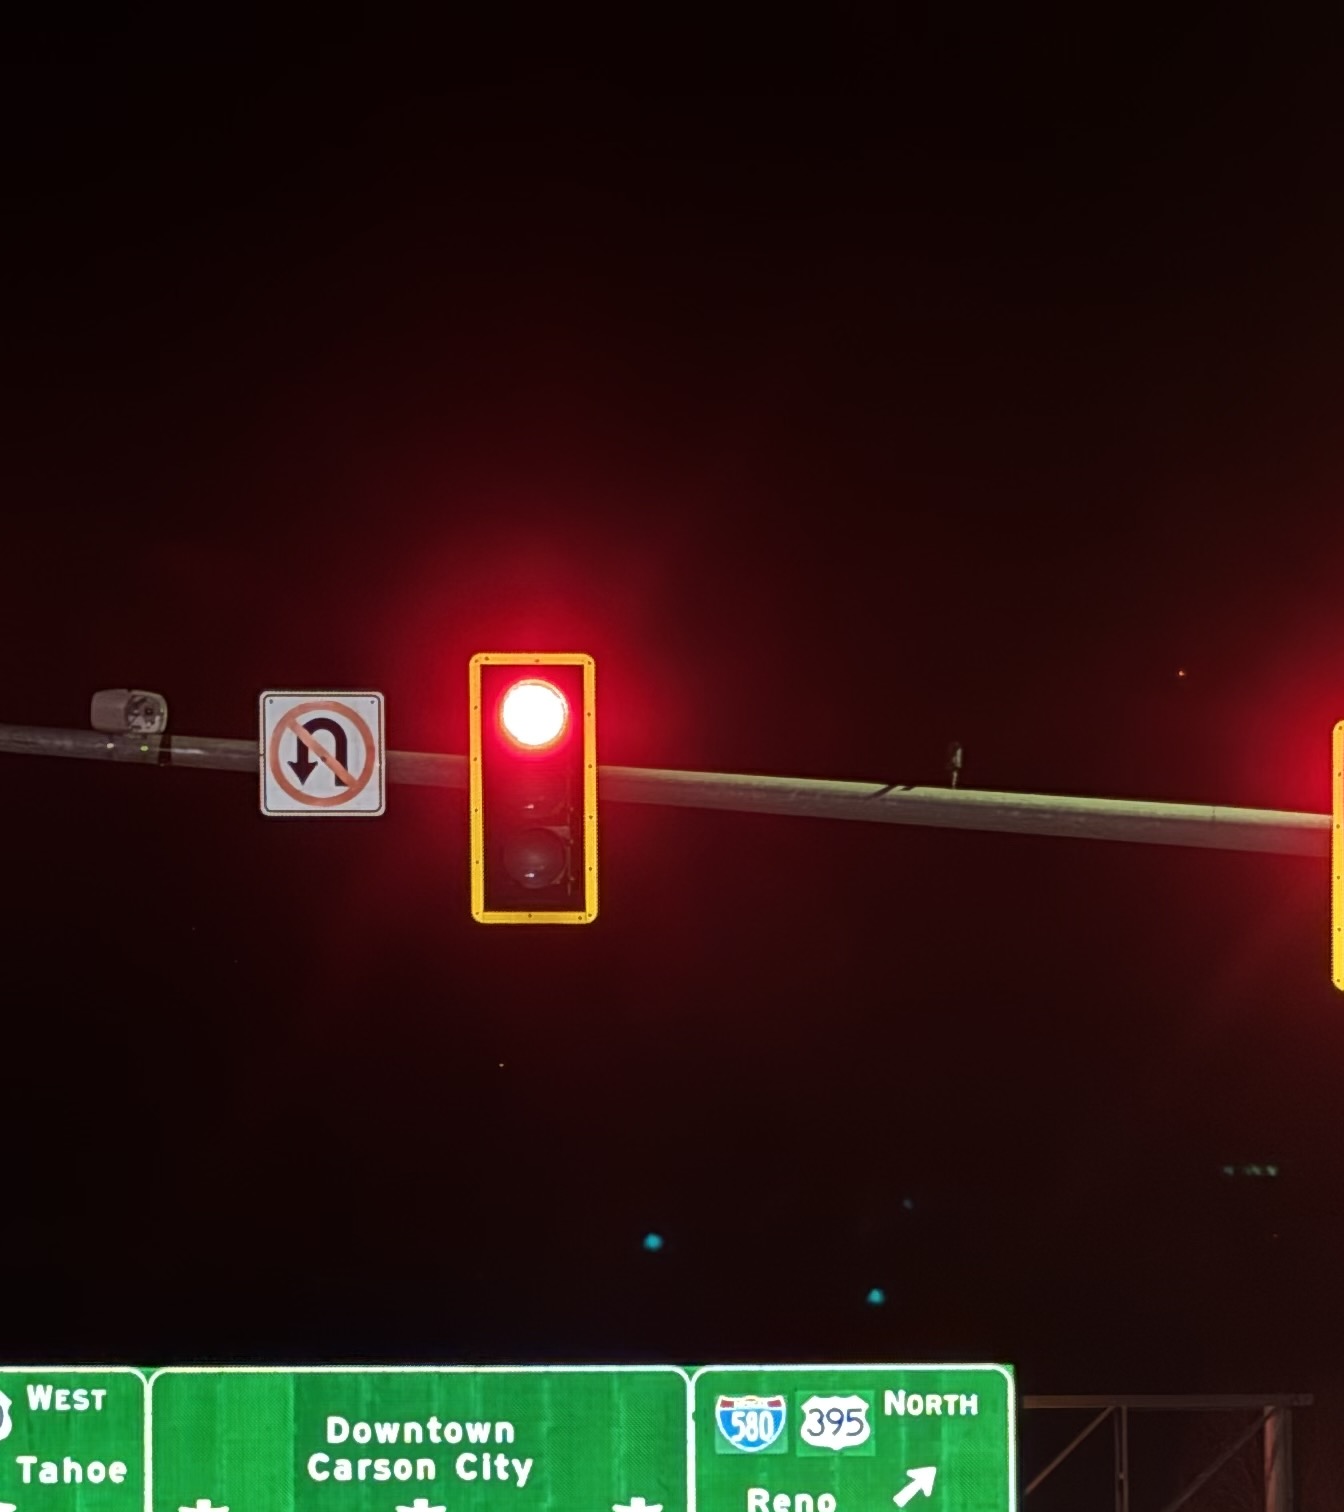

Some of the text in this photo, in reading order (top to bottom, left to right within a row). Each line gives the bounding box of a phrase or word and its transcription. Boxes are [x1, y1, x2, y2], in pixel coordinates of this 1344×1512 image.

[26, 1384, 107, 1411] WEST
[730, 1410, 776, 1443] 580
[806, 1389, 979, 1438] 395 NORTH
[326, 1415, 515, 1445] Downtown
[15, 1455, 128, 1484] Tahoe
[307, 1452, 534, 1488] Carson City
